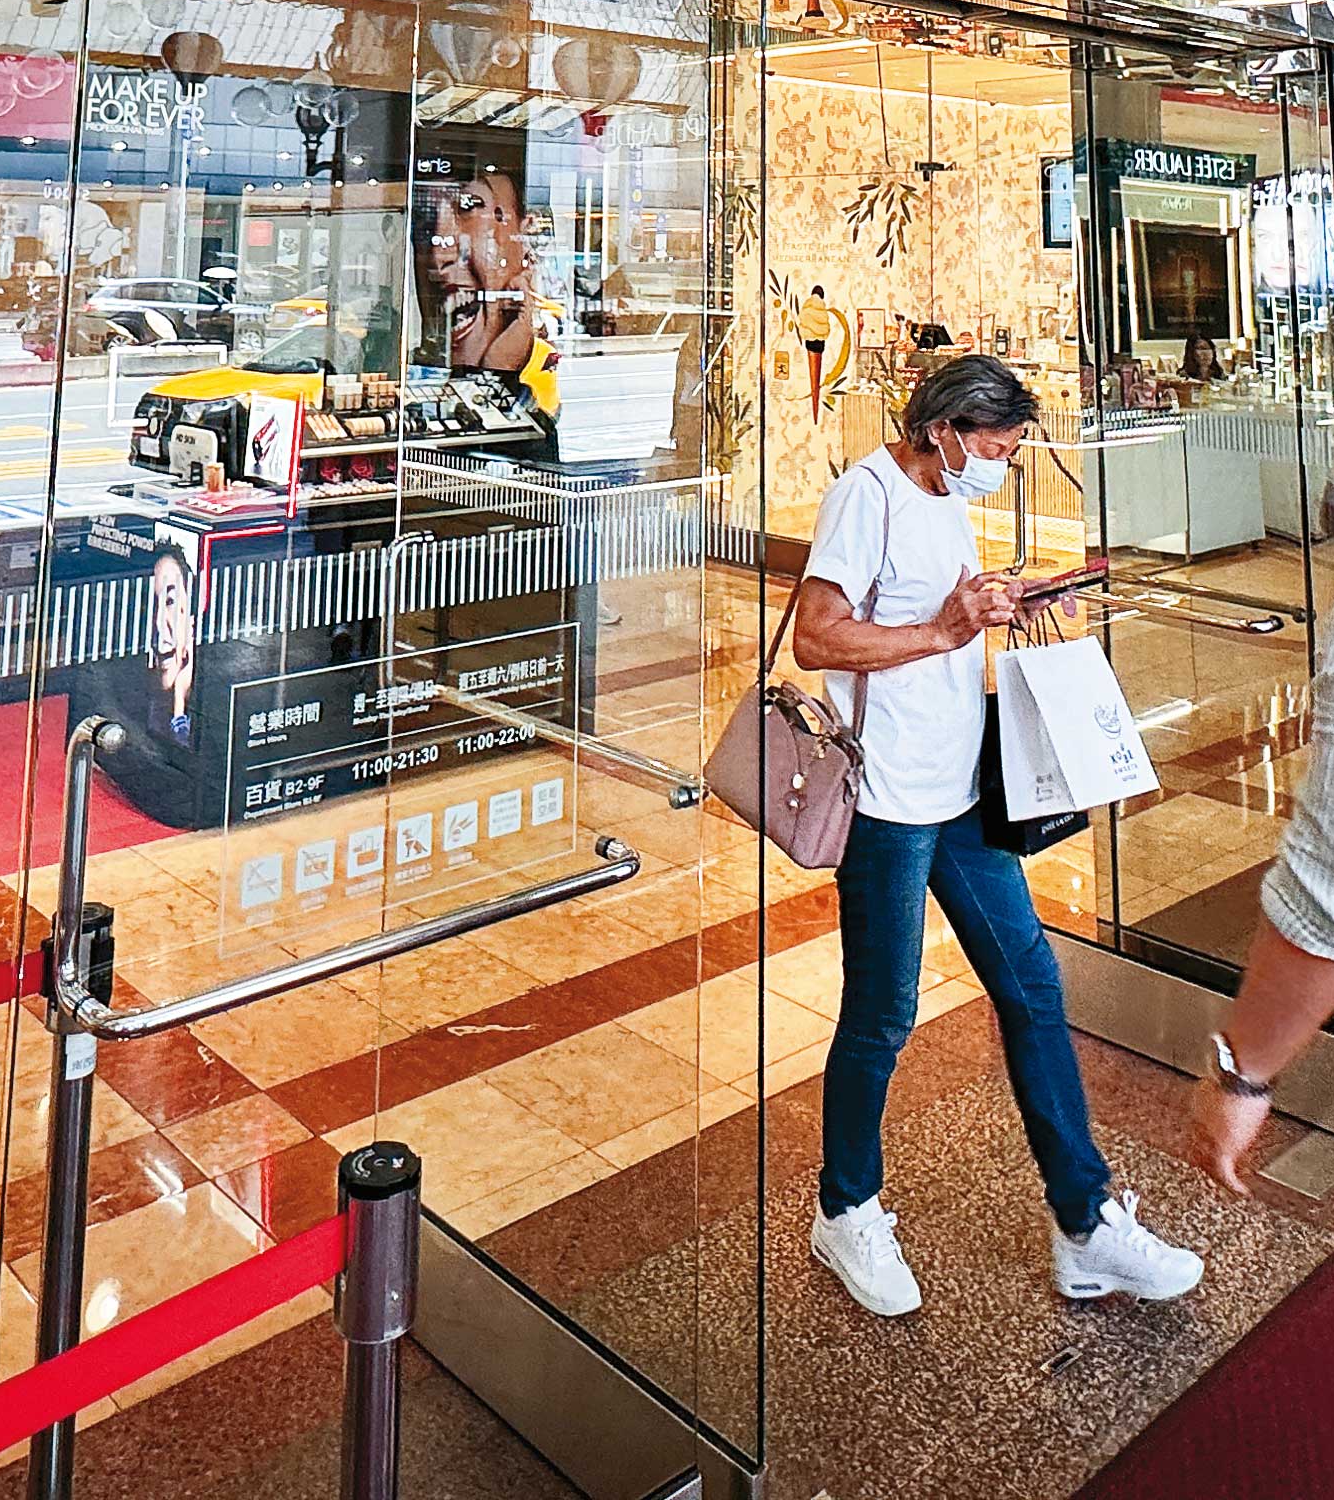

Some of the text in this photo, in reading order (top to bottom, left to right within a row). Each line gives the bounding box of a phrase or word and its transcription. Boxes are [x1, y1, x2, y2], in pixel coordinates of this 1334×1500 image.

[88, 73, 208, 106] MAKE UP
[87, 98, 205, 131] FOR EVER
[248, 702, 320, 736] 營業時間
[457, 723, 536, 755] 11:00-22:00
[352, 745, 439, 780] 11:00-21:30
[245, 774, 325, 808] 百貨 B2-9F
